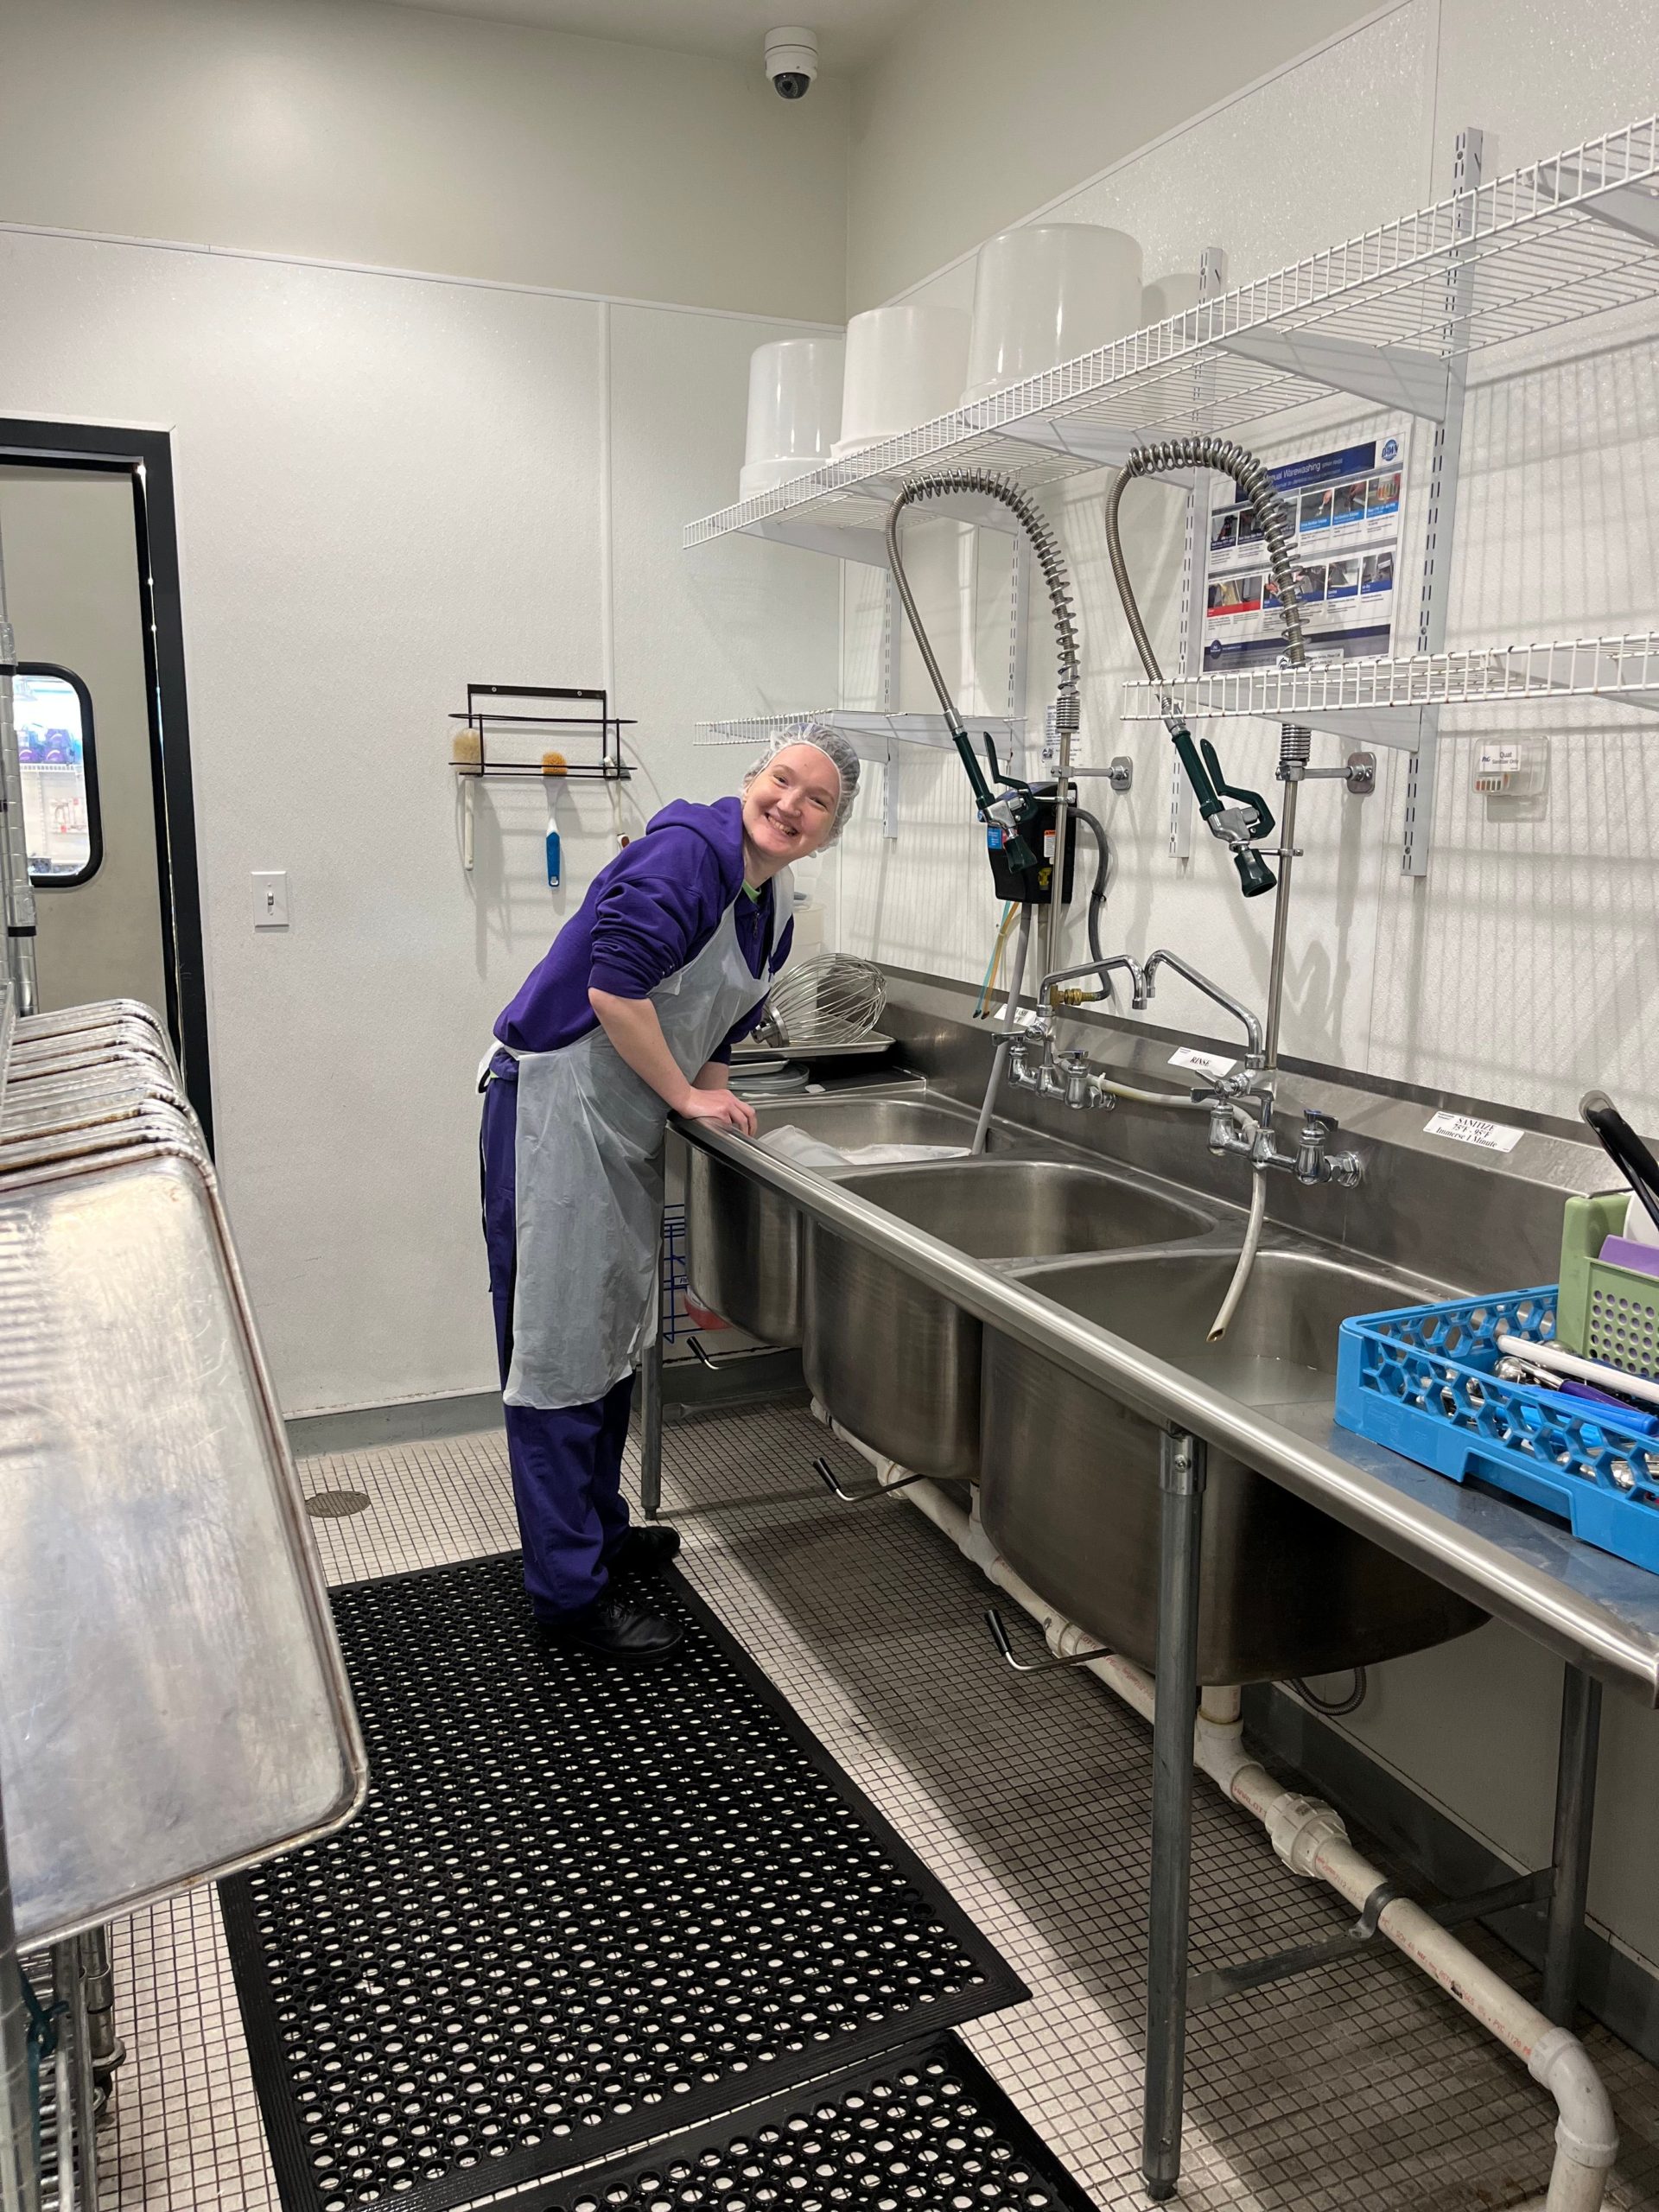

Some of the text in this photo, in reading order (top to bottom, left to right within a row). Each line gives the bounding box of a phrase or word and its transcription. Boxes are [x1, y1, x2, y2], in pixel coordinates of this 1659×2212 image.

[1283, 462, 1321, 479] Warewashing
[1189, 1056, 1211, 1067] RINSE
[1458, 1116, 1495, 1132] SANITIZE
[1436, 1127, 1466, 1141] Immerse
[1473, 1135, 1497, 1148] Minute
